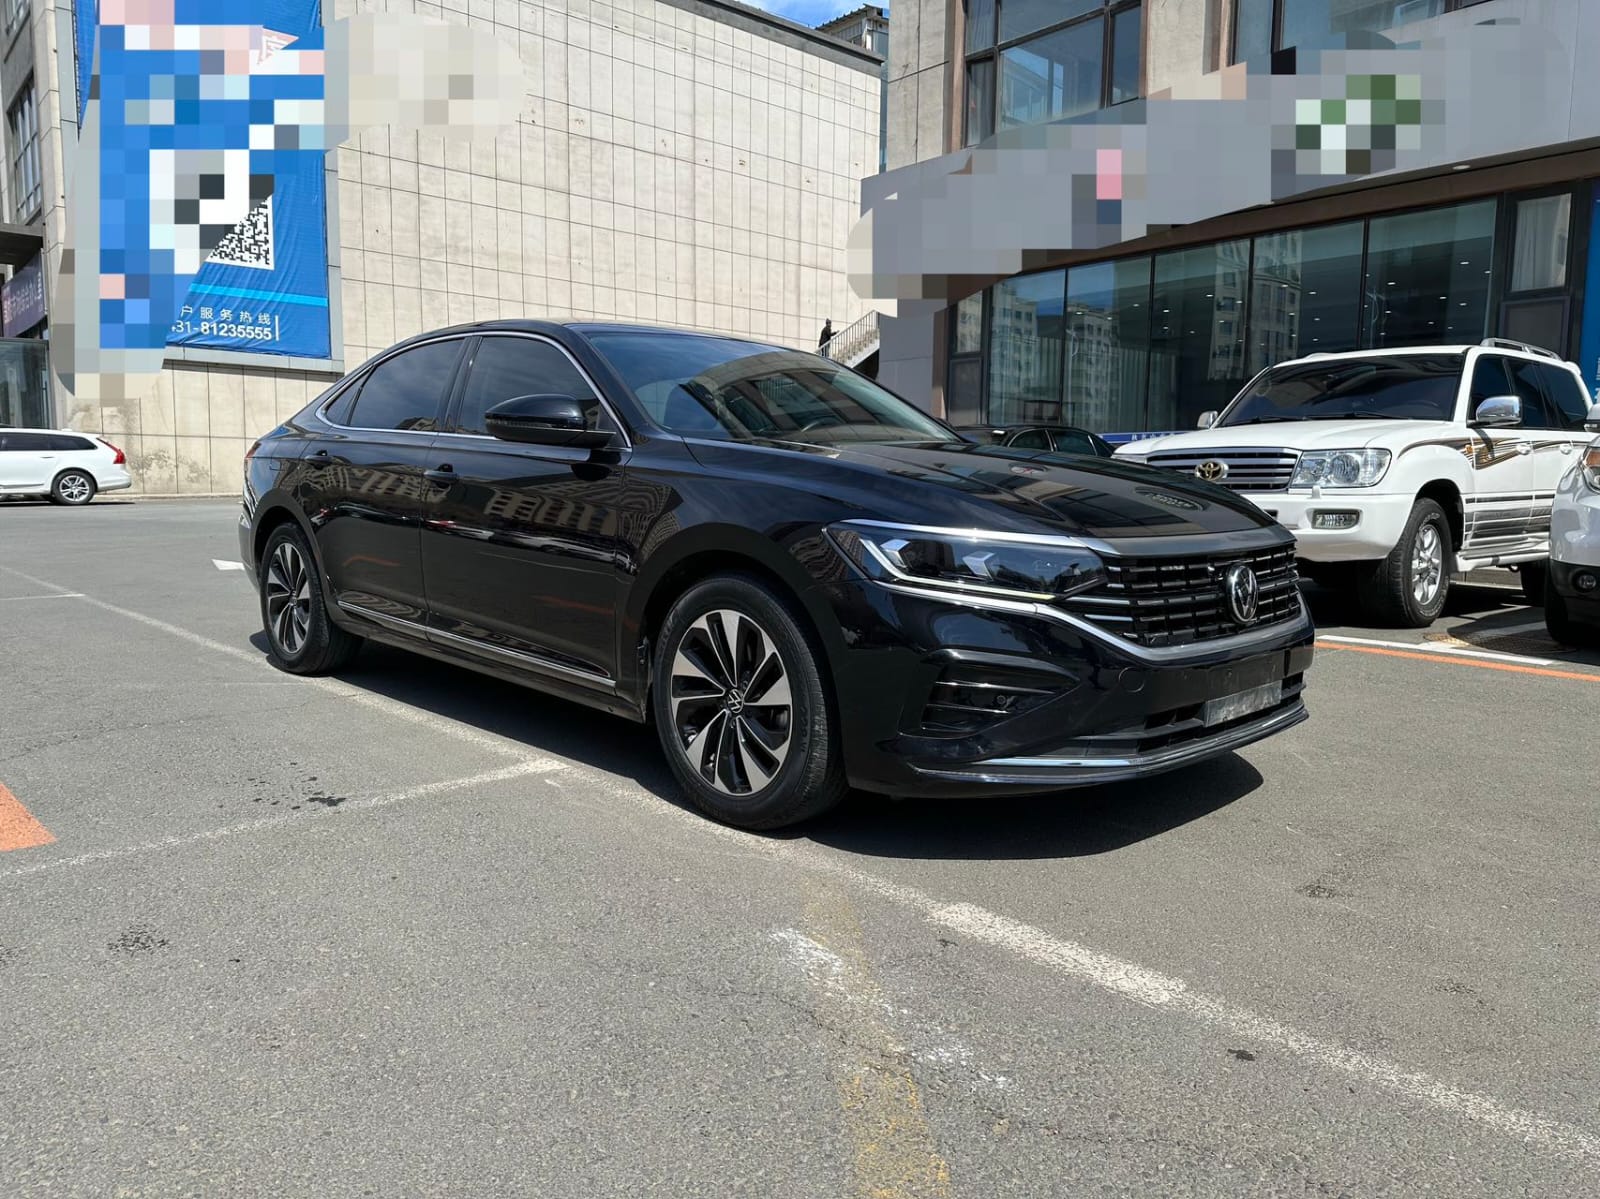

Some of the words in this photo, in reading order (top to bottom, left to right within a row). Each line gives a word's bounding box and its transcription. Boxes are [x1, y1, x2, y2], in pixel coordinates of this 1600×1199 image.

[180, 305, 271, 325] 户服务热线
